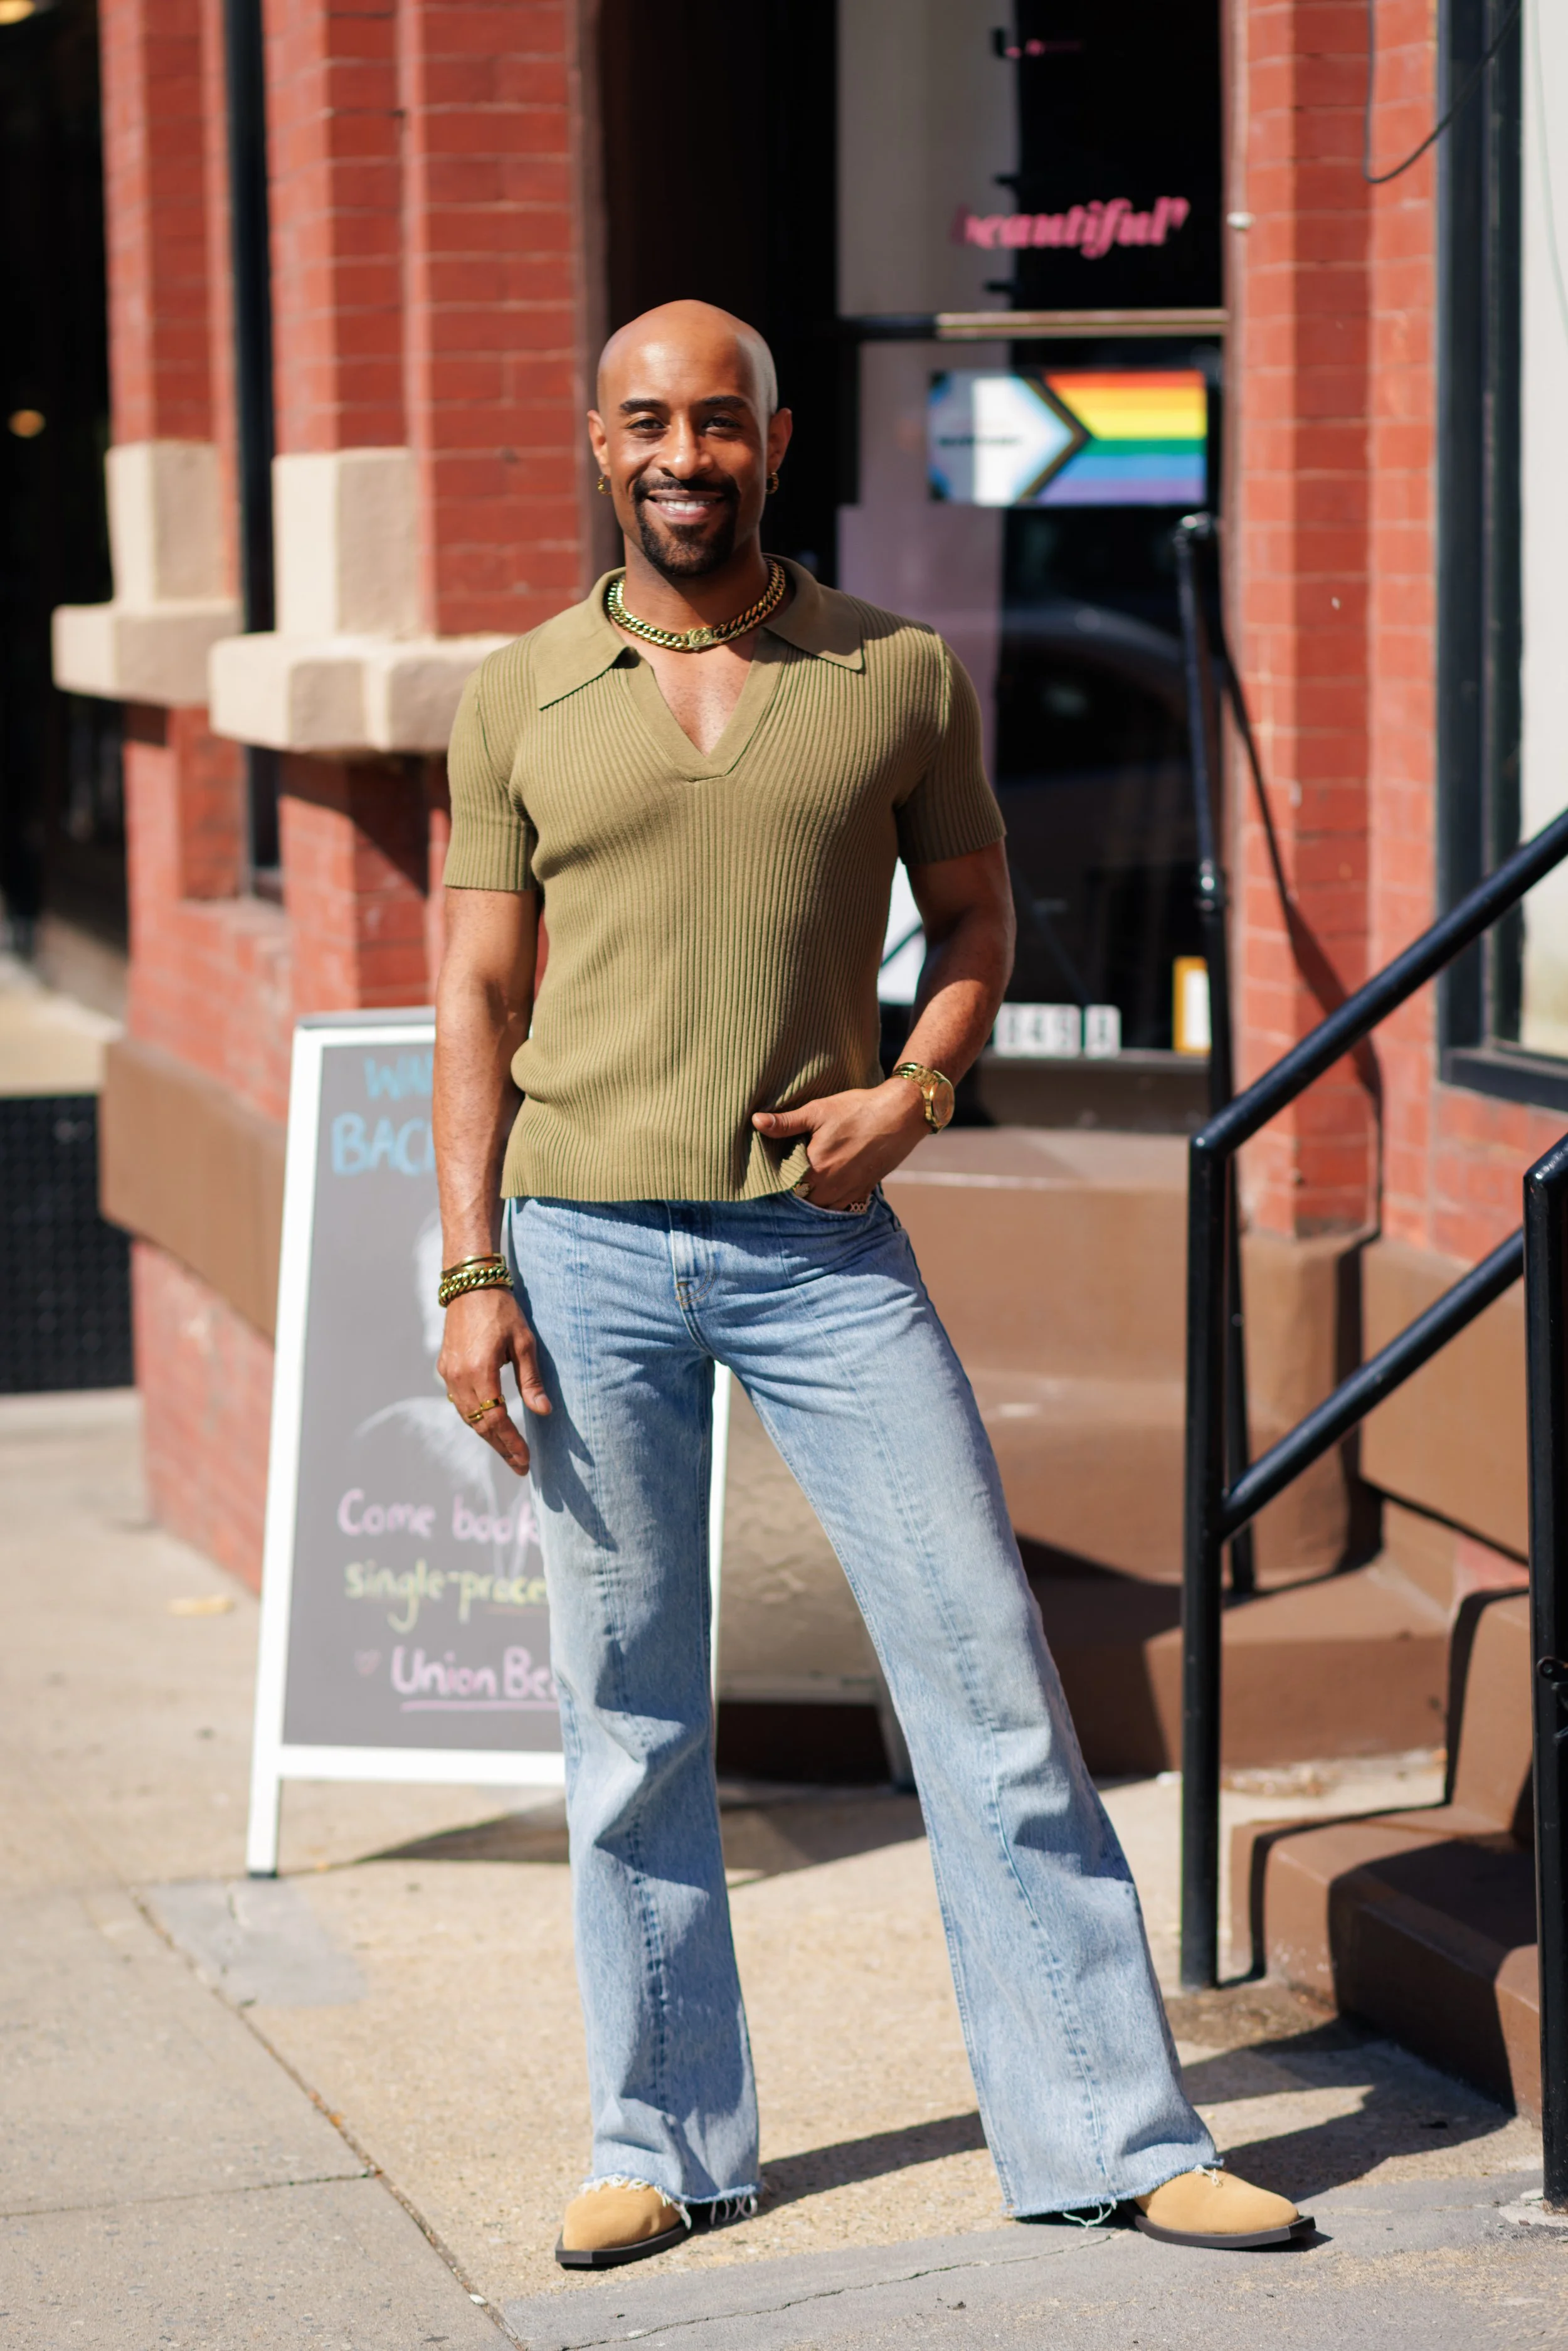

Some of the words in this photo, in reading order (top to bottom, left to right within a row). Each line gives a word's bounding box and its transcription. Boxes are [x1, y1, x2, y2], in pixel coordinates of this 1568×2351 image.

[337, 1487, 436, 1539] Come
[451, 1493, 541, 1547] book
[390, 1645, 498, 1696] Union
